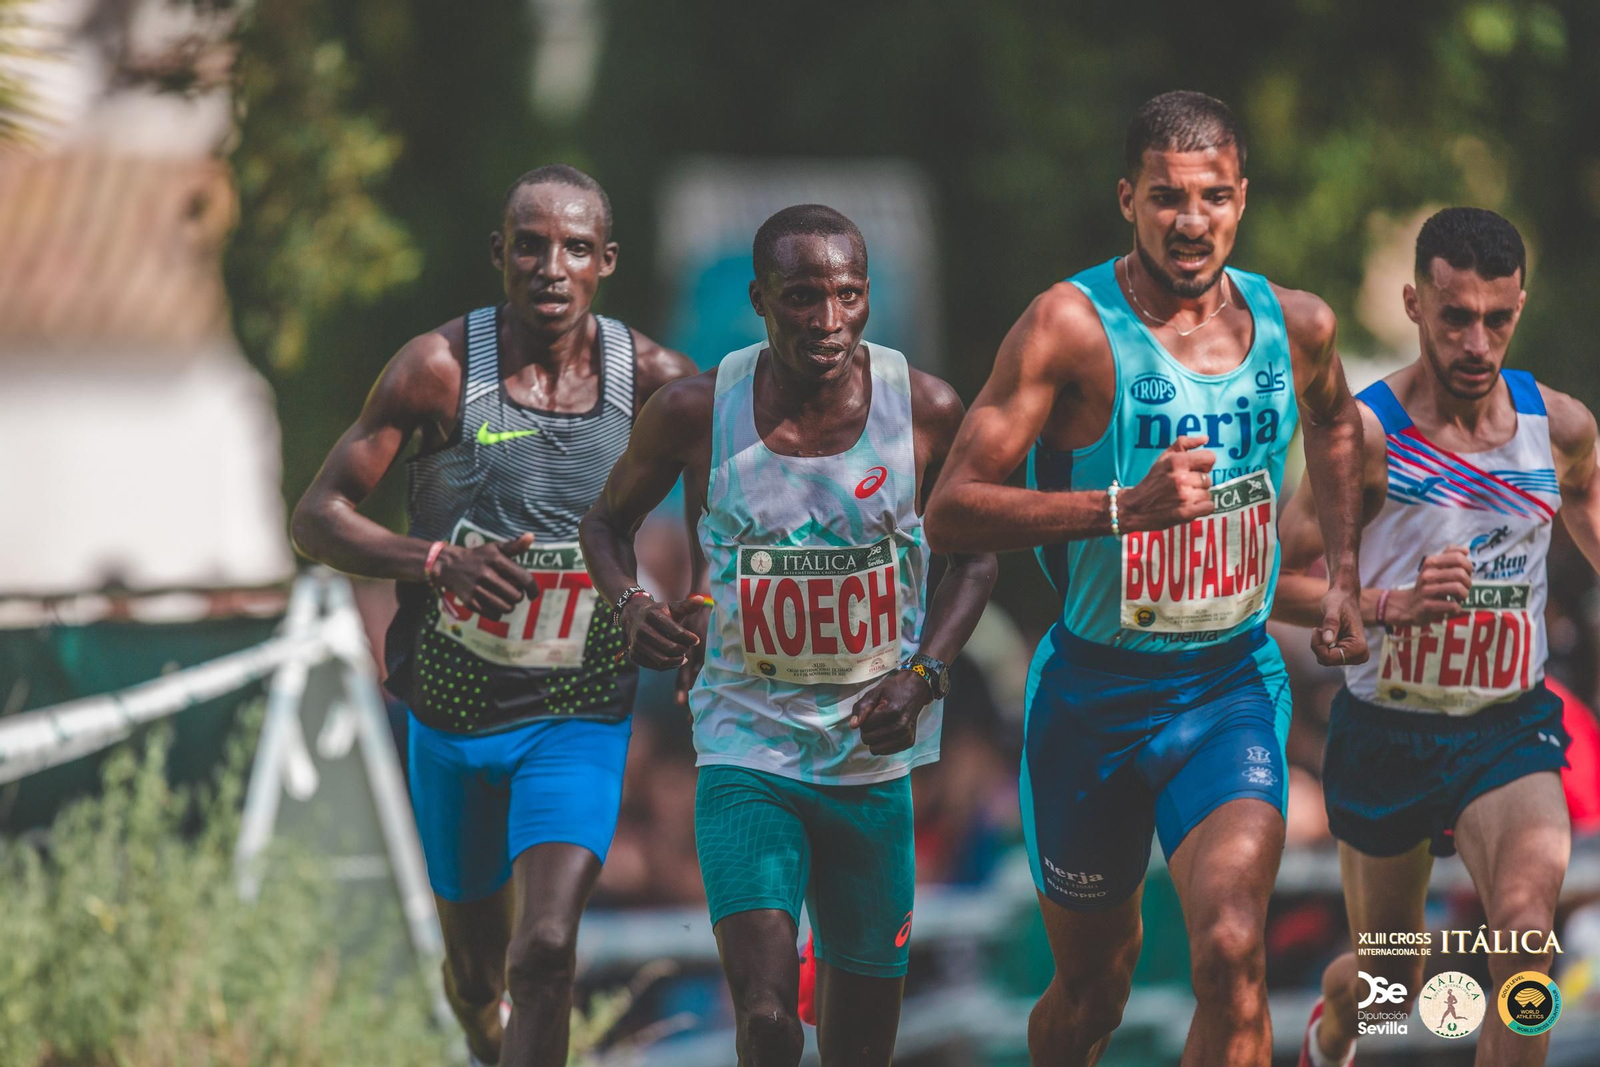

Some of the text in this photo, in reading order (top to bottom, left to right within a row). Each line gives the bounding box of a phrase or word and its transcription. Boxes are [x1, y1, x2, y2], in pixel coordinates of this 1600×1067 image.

[1133, 379, 1175, 401] TROPS
[1135, 396, 1280, 460] nerja
[783, 551, 857, 571] ITÁLICA
[1126, 502, 1271, 603] BOUFALJAT
[740, 566, 897, 657] KOECH
[1044, 856, 1104, 885] nerja
